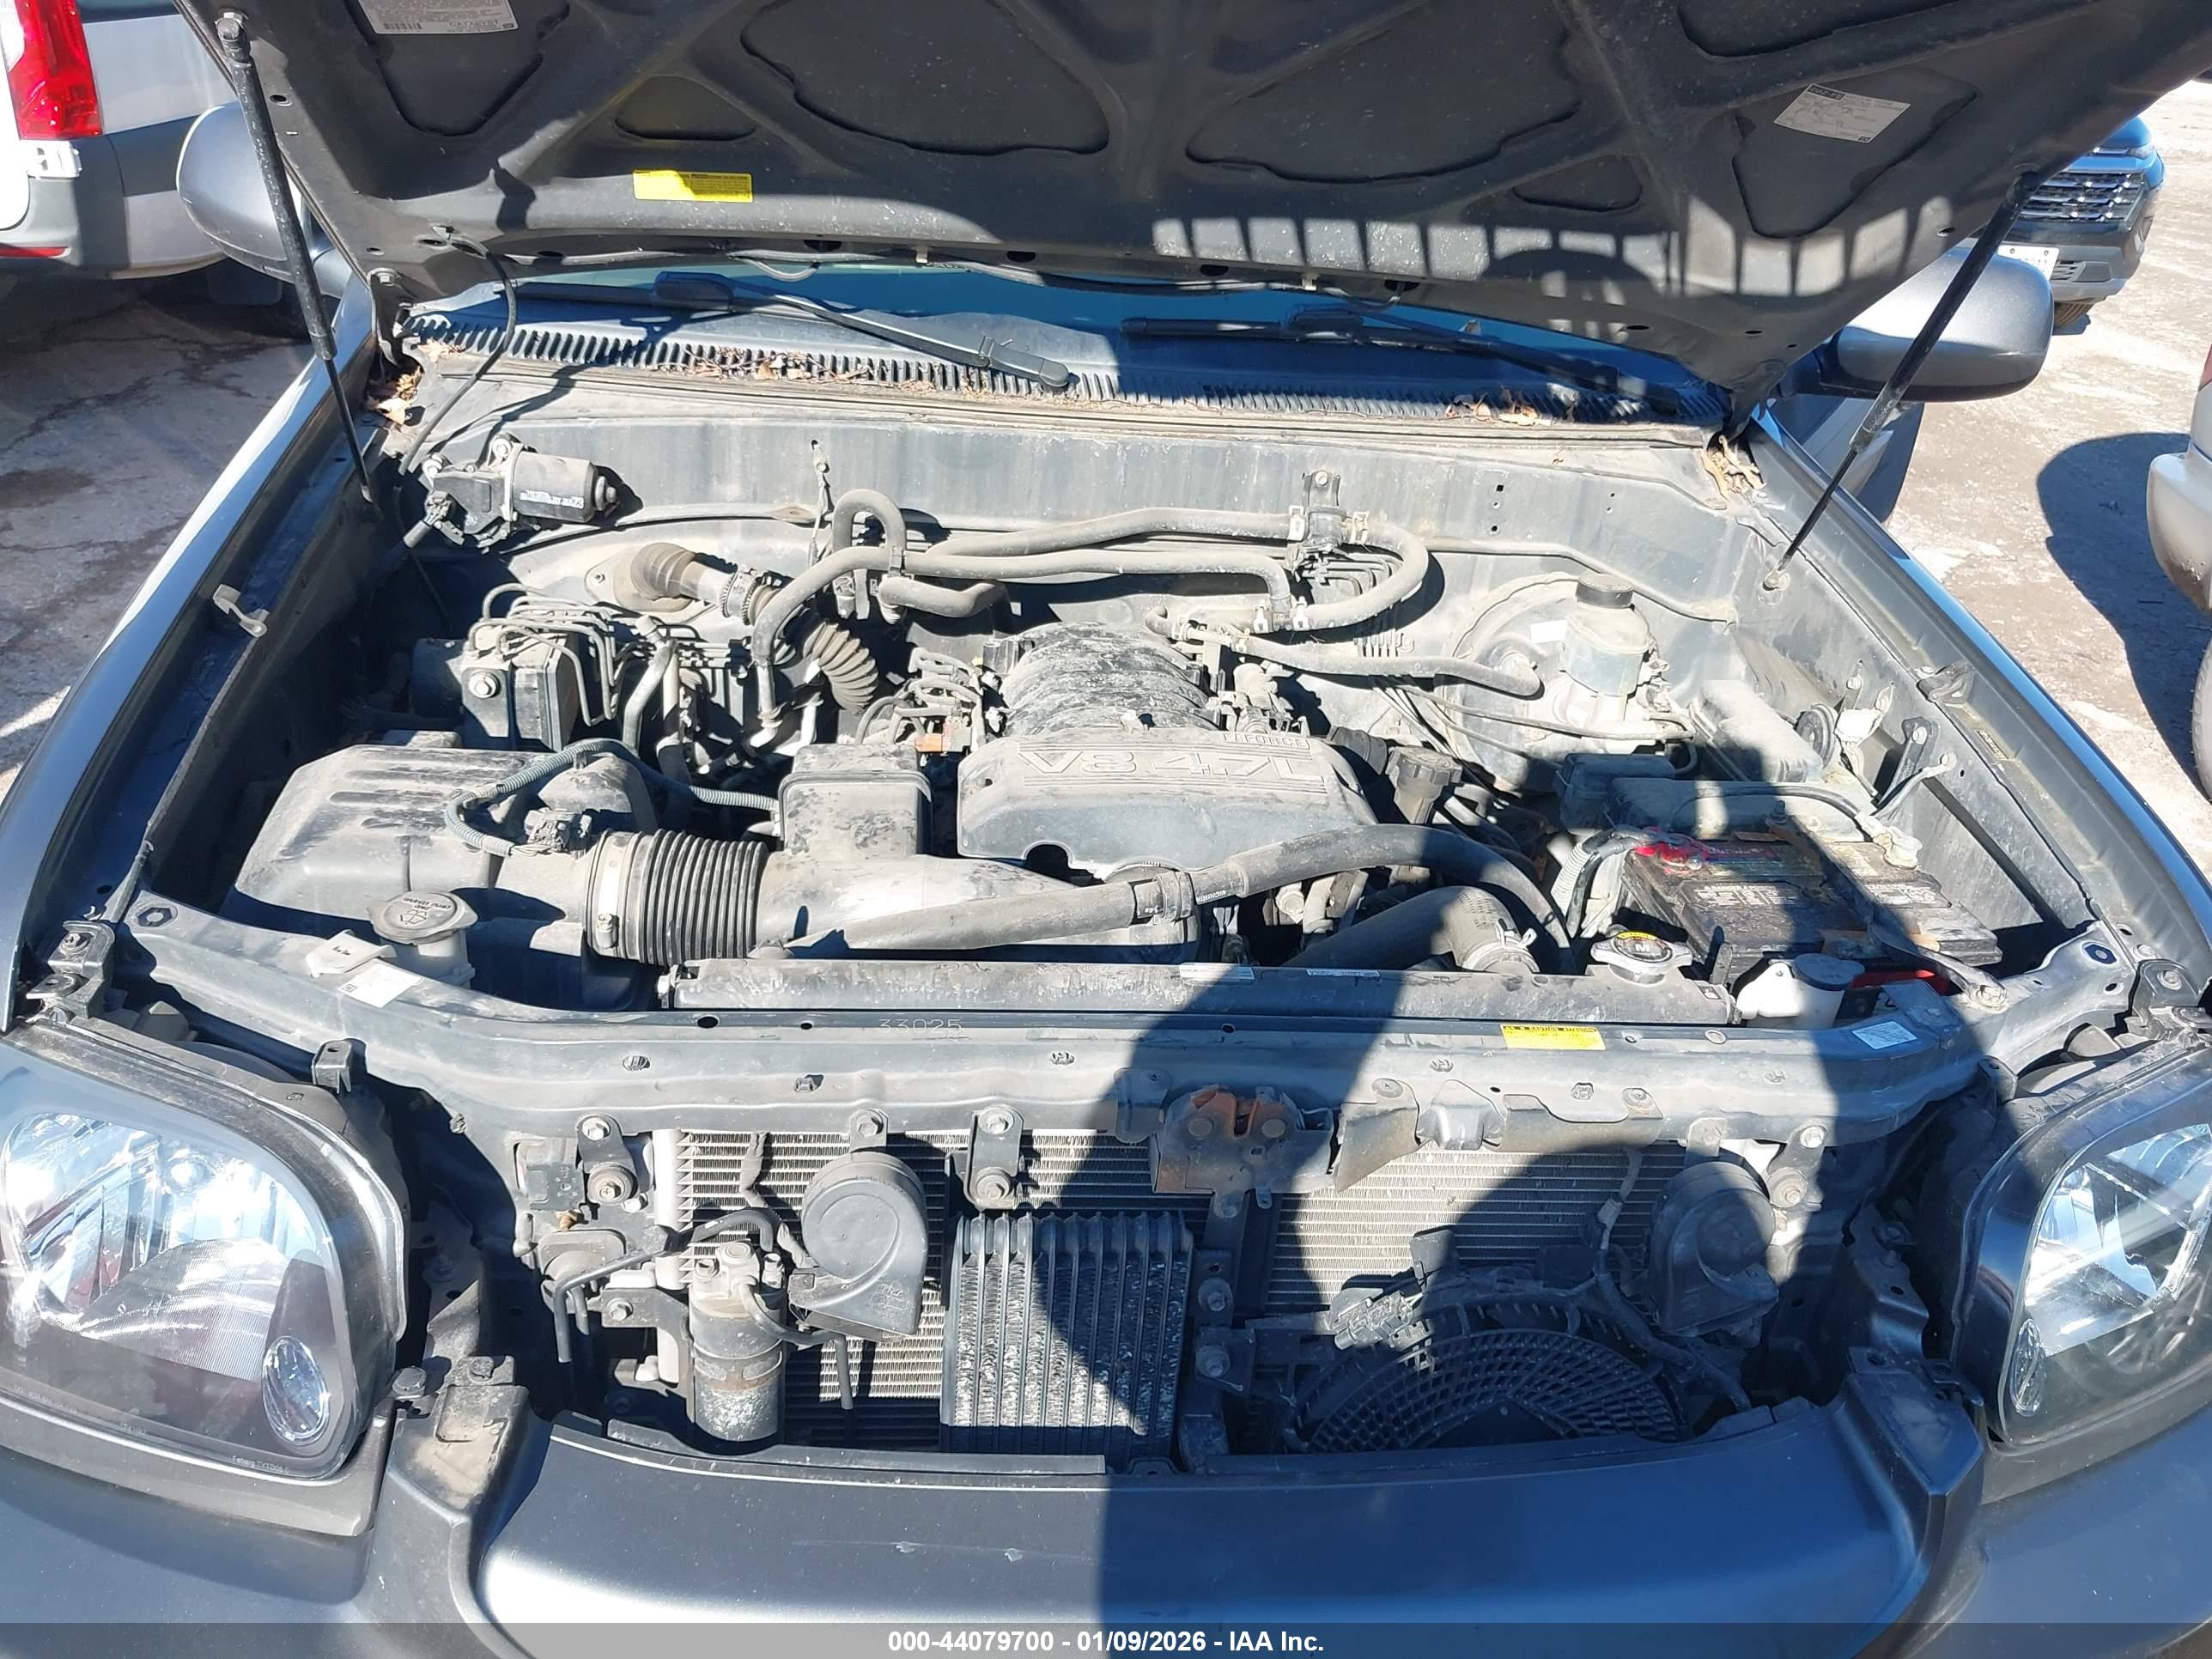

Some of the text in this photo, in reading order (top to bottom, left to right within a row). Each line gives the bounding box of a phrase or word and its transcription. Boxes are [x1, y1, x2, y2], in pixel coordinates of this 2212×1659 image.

[1018, 750, 1325, 784] V8 4.7L
[878, 1018, 963, 1034] 33025
